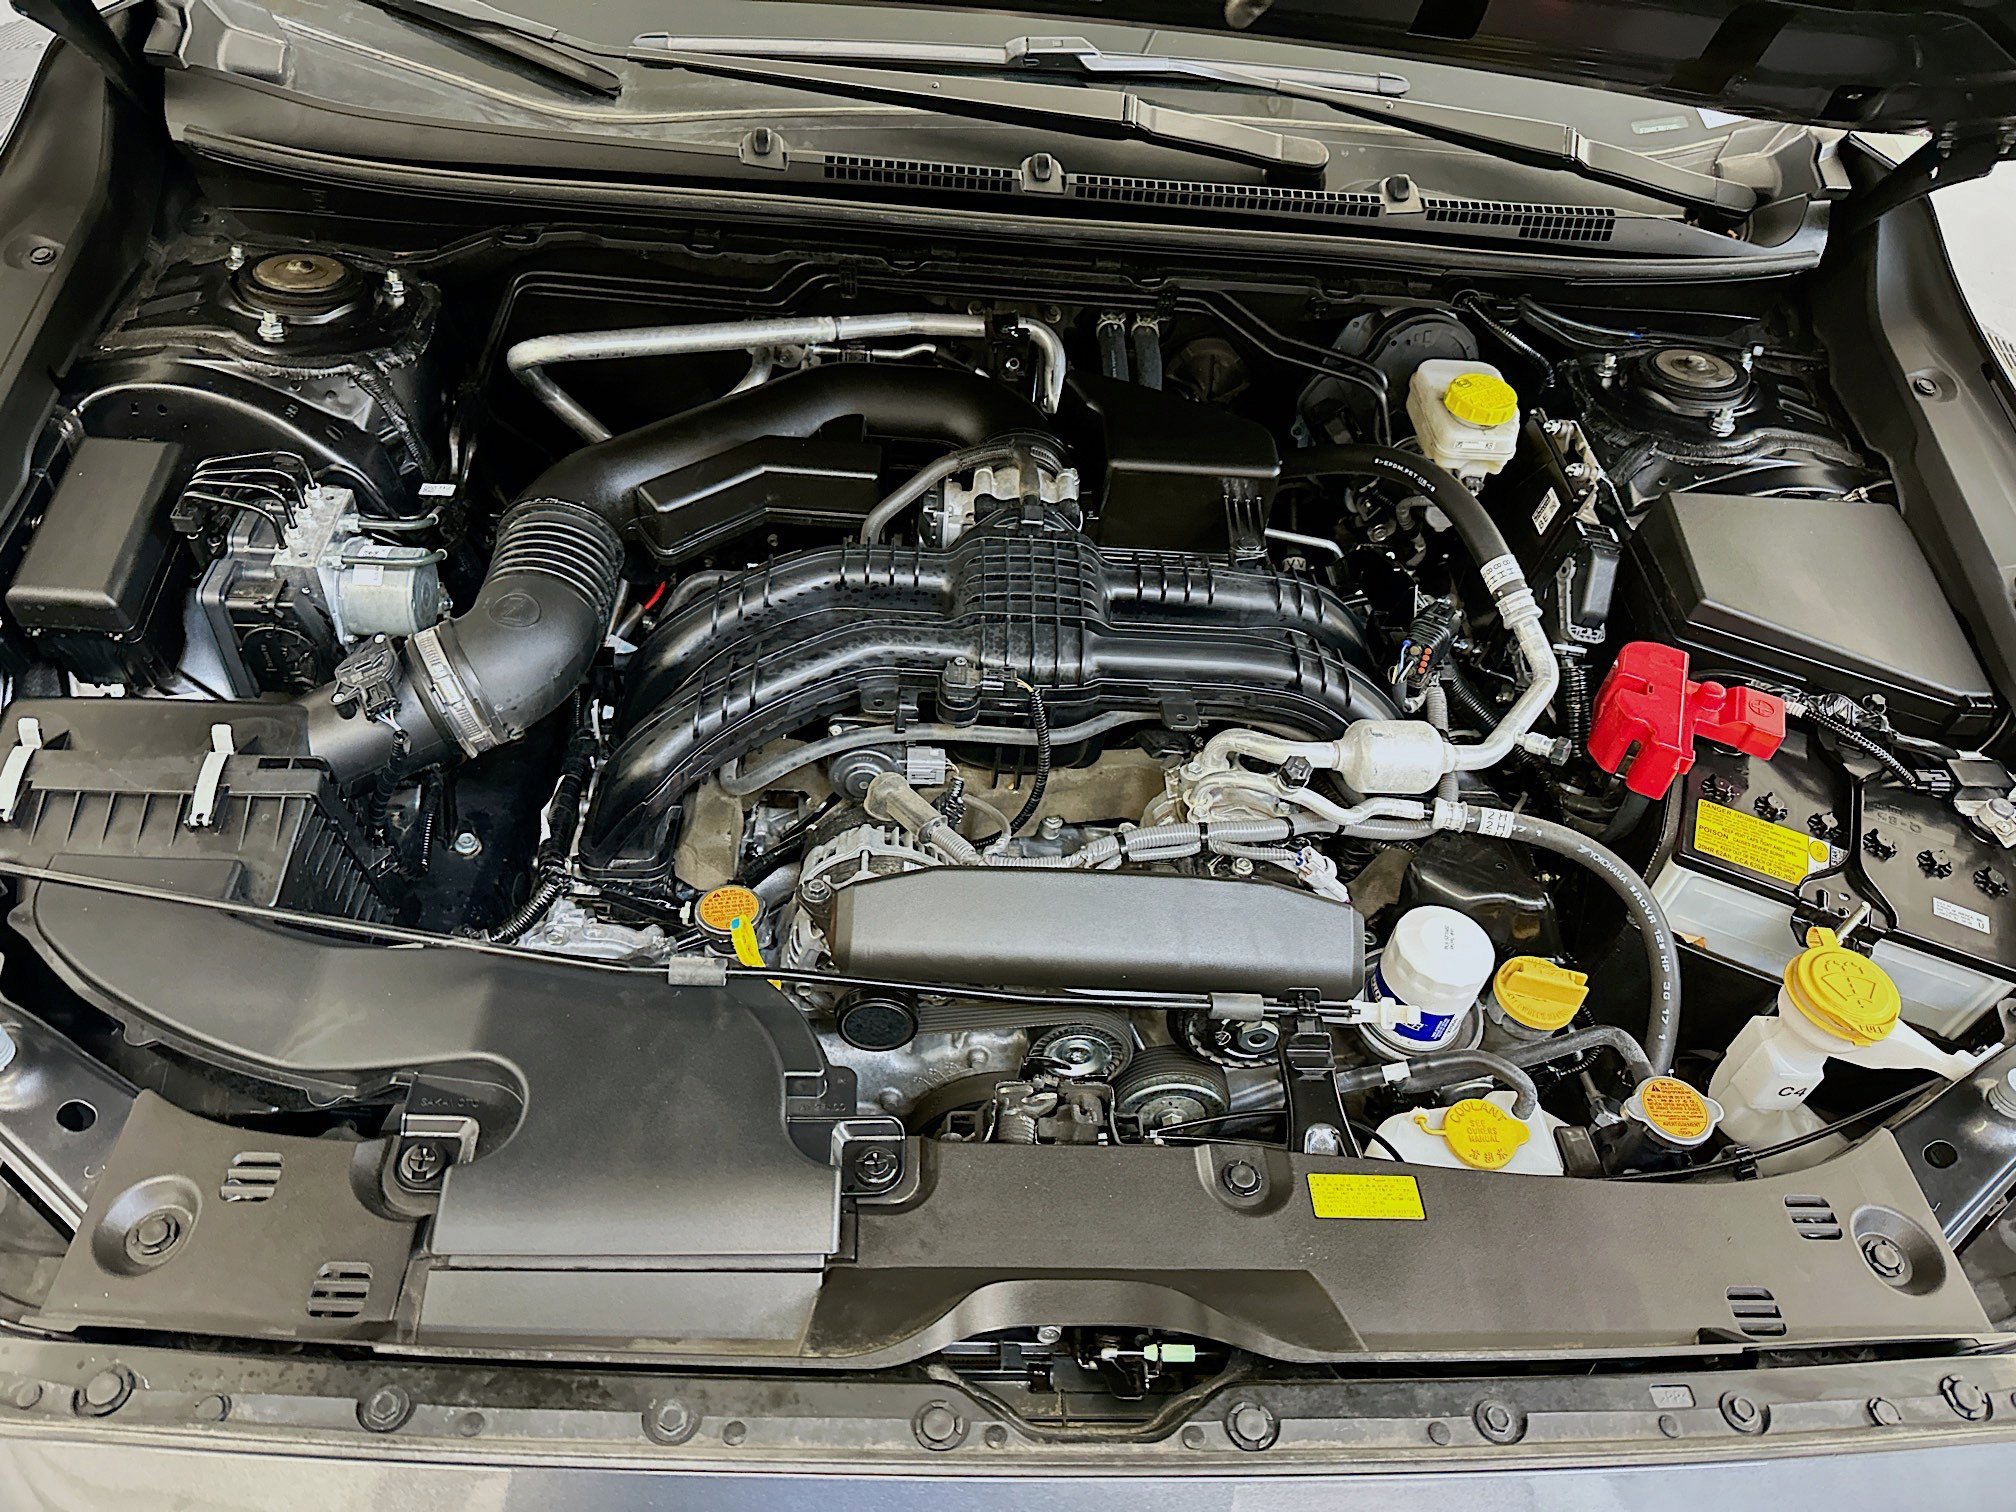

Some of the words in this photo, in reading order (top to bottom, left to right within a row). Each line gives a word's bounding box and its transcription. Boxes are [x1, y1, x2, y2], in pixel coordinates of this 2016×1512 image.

[1700, 801, 1731, 817] DANGER
[1698, 825, 1729, 840] POISON
[1697, 843, 1715, 853] 20HR
[1734, 855, 1749, 868] CCA
[1589, 852, 1629, 884] YOKOHAMA
[1858, 1024, 1884, 1035] FULL
[1778, 1086, 1807, 1097] C4
[1449, 1101, 1508, 1123] COOLANT
[1469, 1119, 1486, 1127] SEE
[1467, 1127, 1498, 1135] OWNERS
[1468, 1134, 1500, 1143] MANUAL
